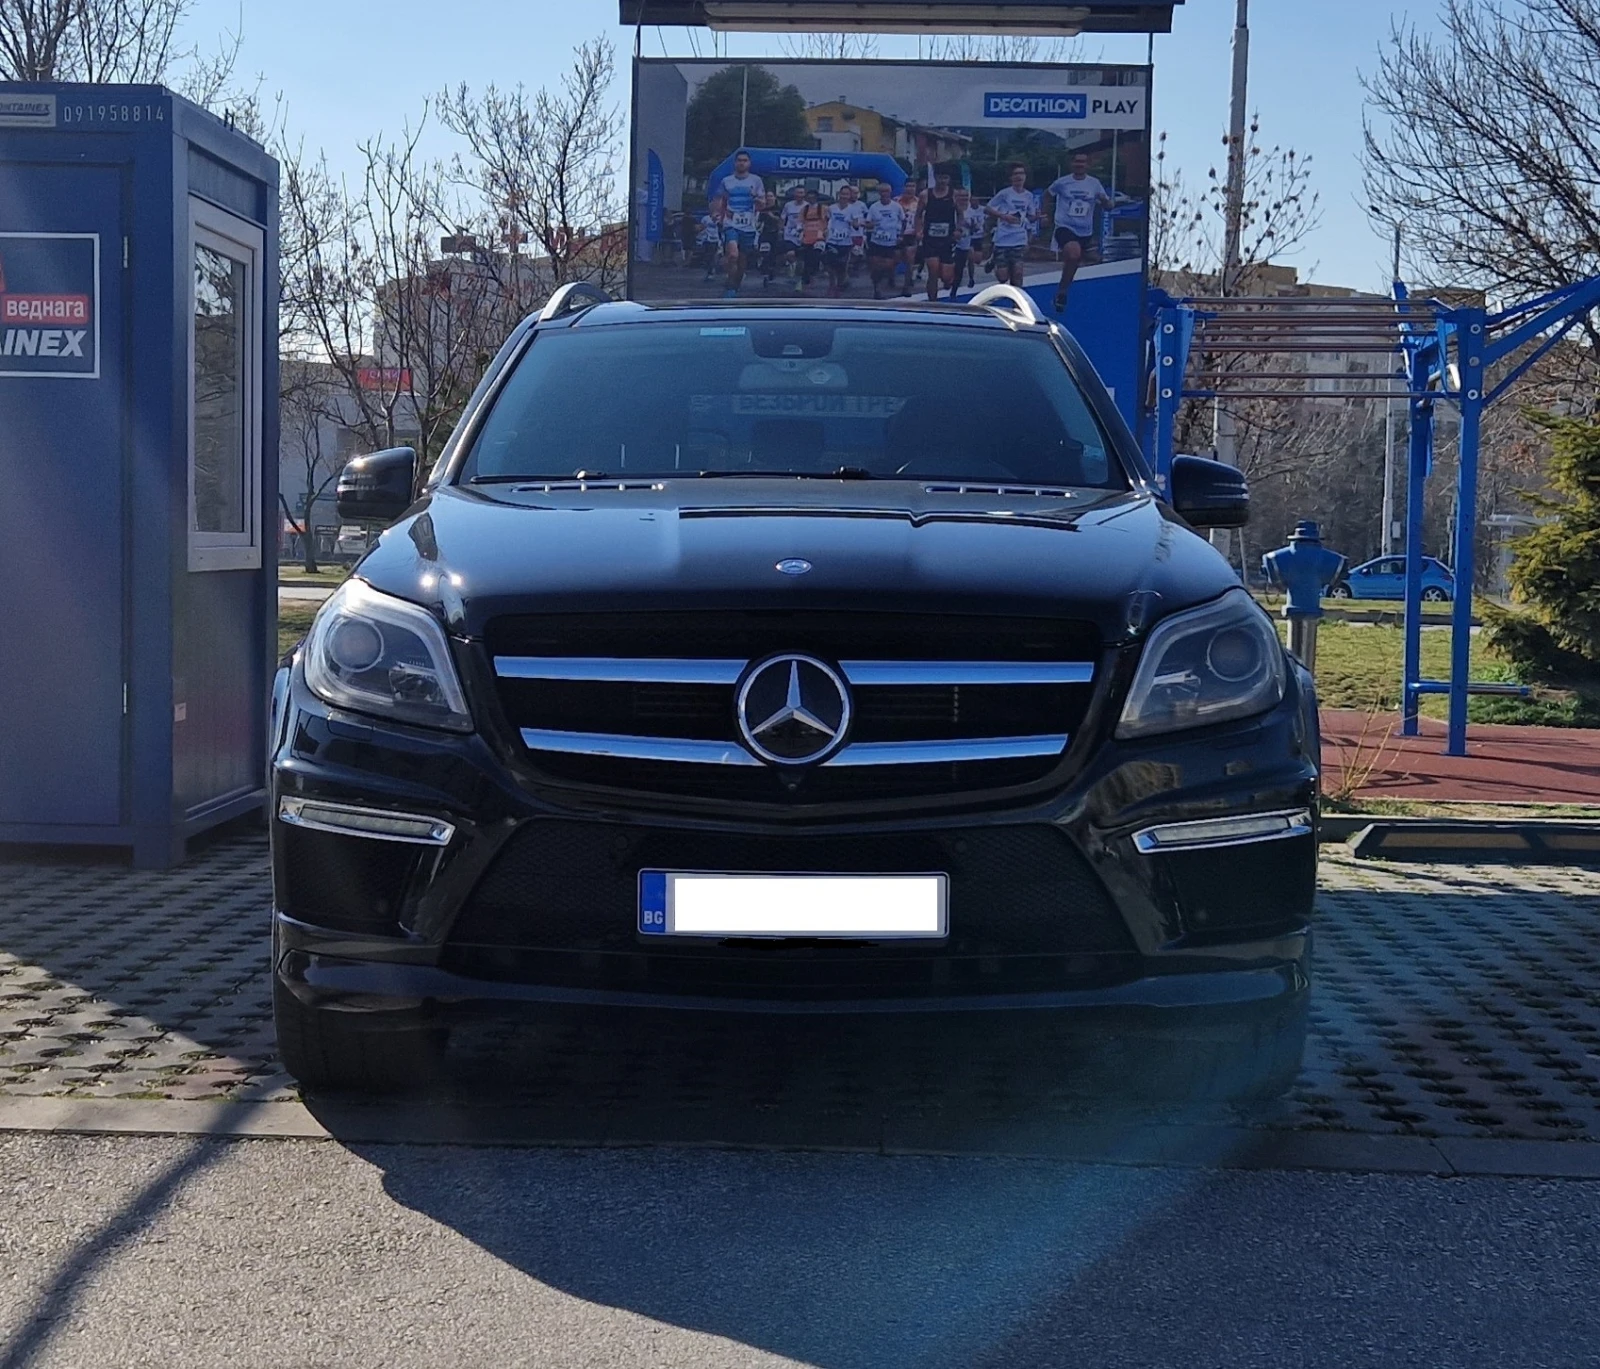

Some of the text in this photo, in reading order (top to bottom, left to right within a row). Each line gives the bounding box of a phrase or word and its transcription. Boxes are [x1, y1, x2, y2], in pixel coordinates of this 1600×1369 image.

[63, 105, 164, 123] 091958814
[989, 98, 1138, 114] DECATHLON PLAY
[779, 156, 850, 171] DECATHLON
[6, 299, 85, 320] веднага
[0, 328, 88, 357] INEX
[643, 910, 664, 925] BG
